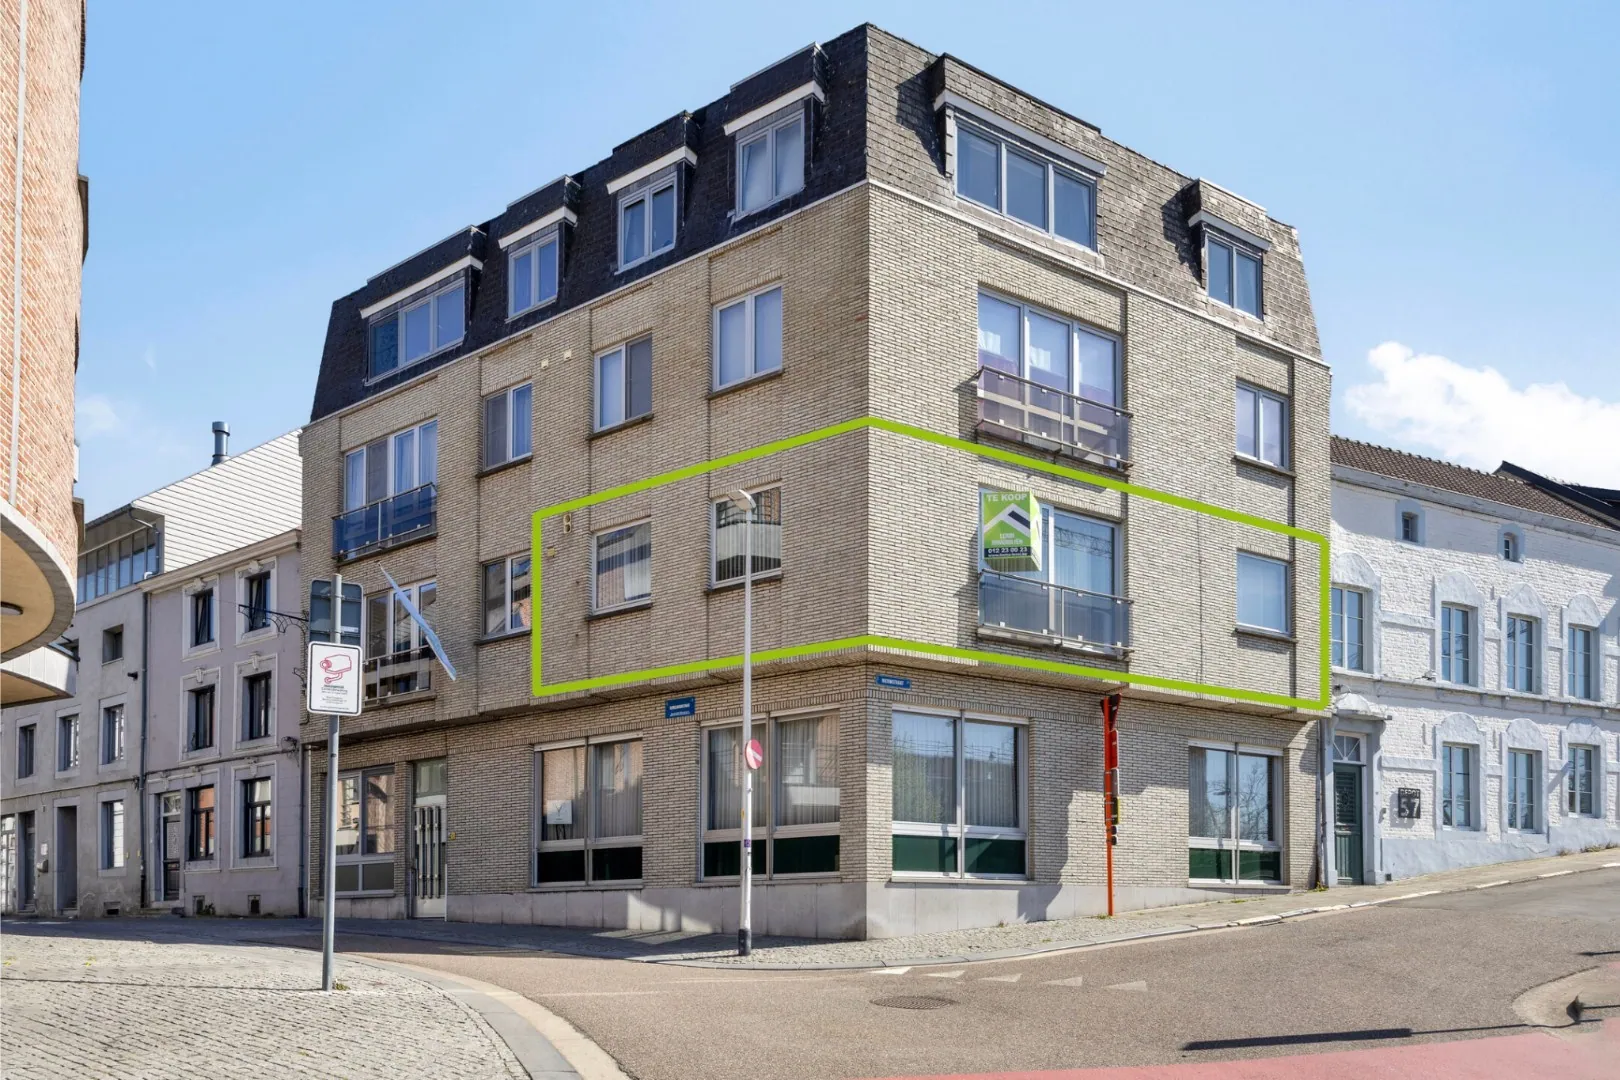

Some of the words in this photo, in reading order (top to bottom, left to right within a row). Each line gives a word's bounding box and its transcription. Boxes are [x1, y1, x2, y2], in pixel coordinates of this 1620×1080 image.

[987, 494, 999, 502] TE
[1001, 493, 1027, 502] KOOP
[1400, 798, 1420, 817] 57
